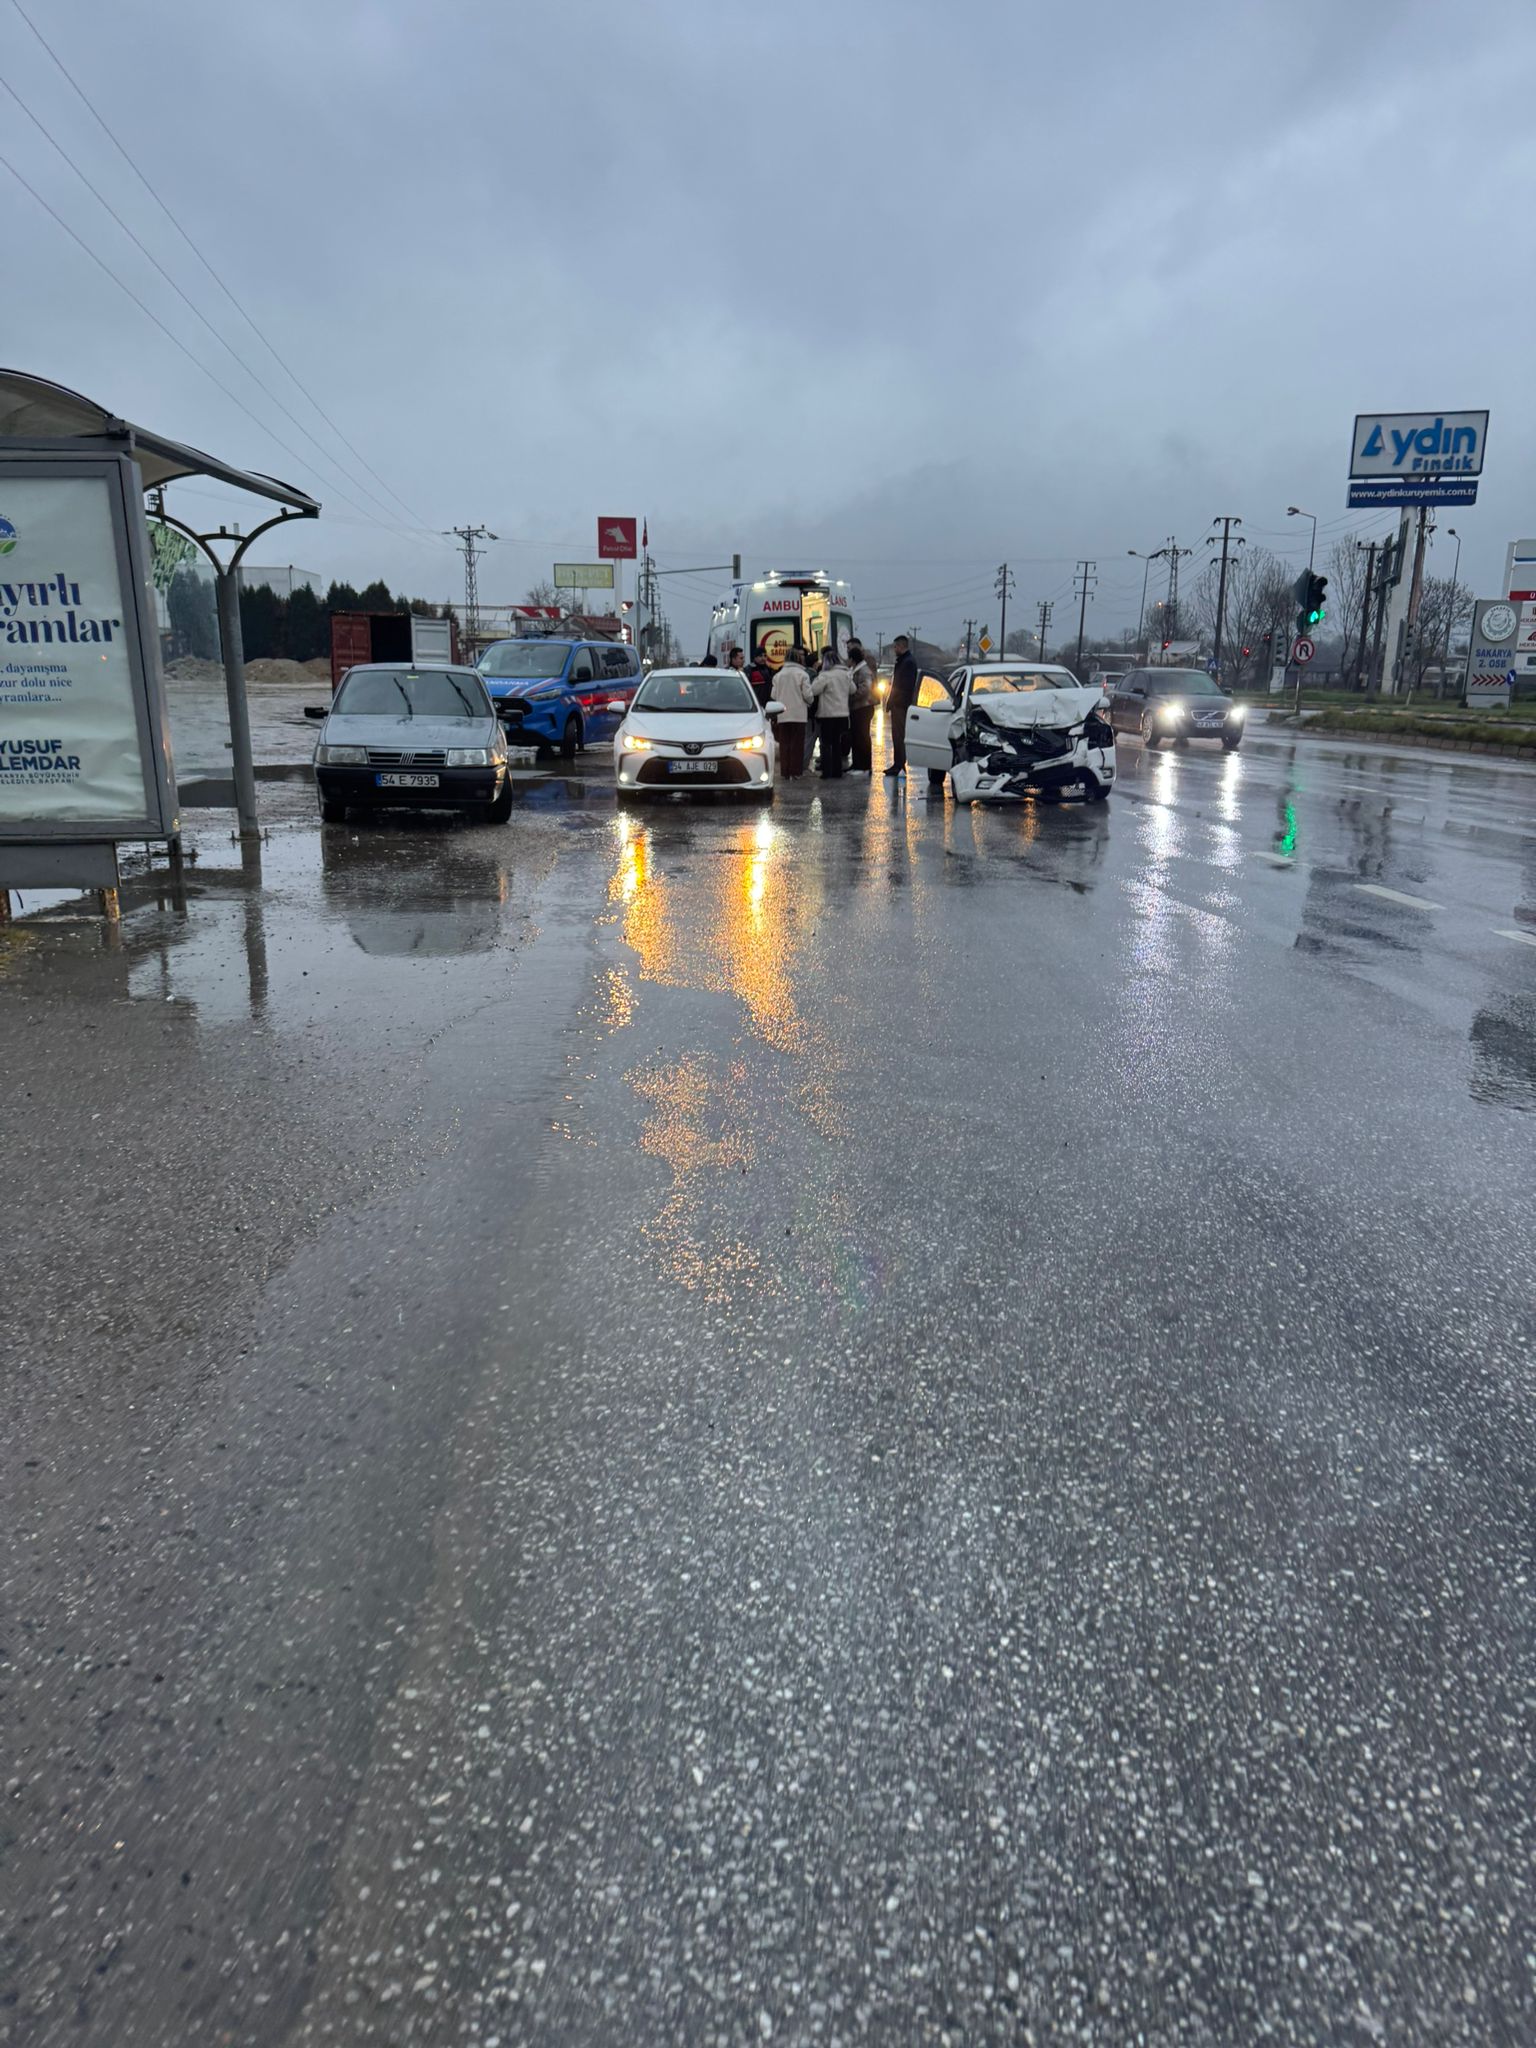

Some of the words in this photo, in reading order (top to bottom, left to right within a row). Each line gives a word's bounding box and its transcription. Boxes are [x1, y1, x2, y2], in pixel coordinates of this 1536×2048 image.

[1360, 418, 1477, 466] Aydın
[1412, 456, 1474, 471] Fındık
[1350, 488, 1476, 499] www.aydinkuruyemis.com.tr
[0, 573, 82, 616] yırlı
[763, 600, 800, 612] AMBU
[770, 648, 789, 657] SAĞLI
[1475, 648, 1512, 658] SAKARYA
[5, 663, 68, 676] dayanışma
[1478, 659, 1487, 668] 2.
[20, 677, 46, 688] dolu
[49, 676, 72, 688] nice
[381, 775, 395, 785] 54
[399, 775, 407, 785] E
[410, 775, 437, 785] 7935
